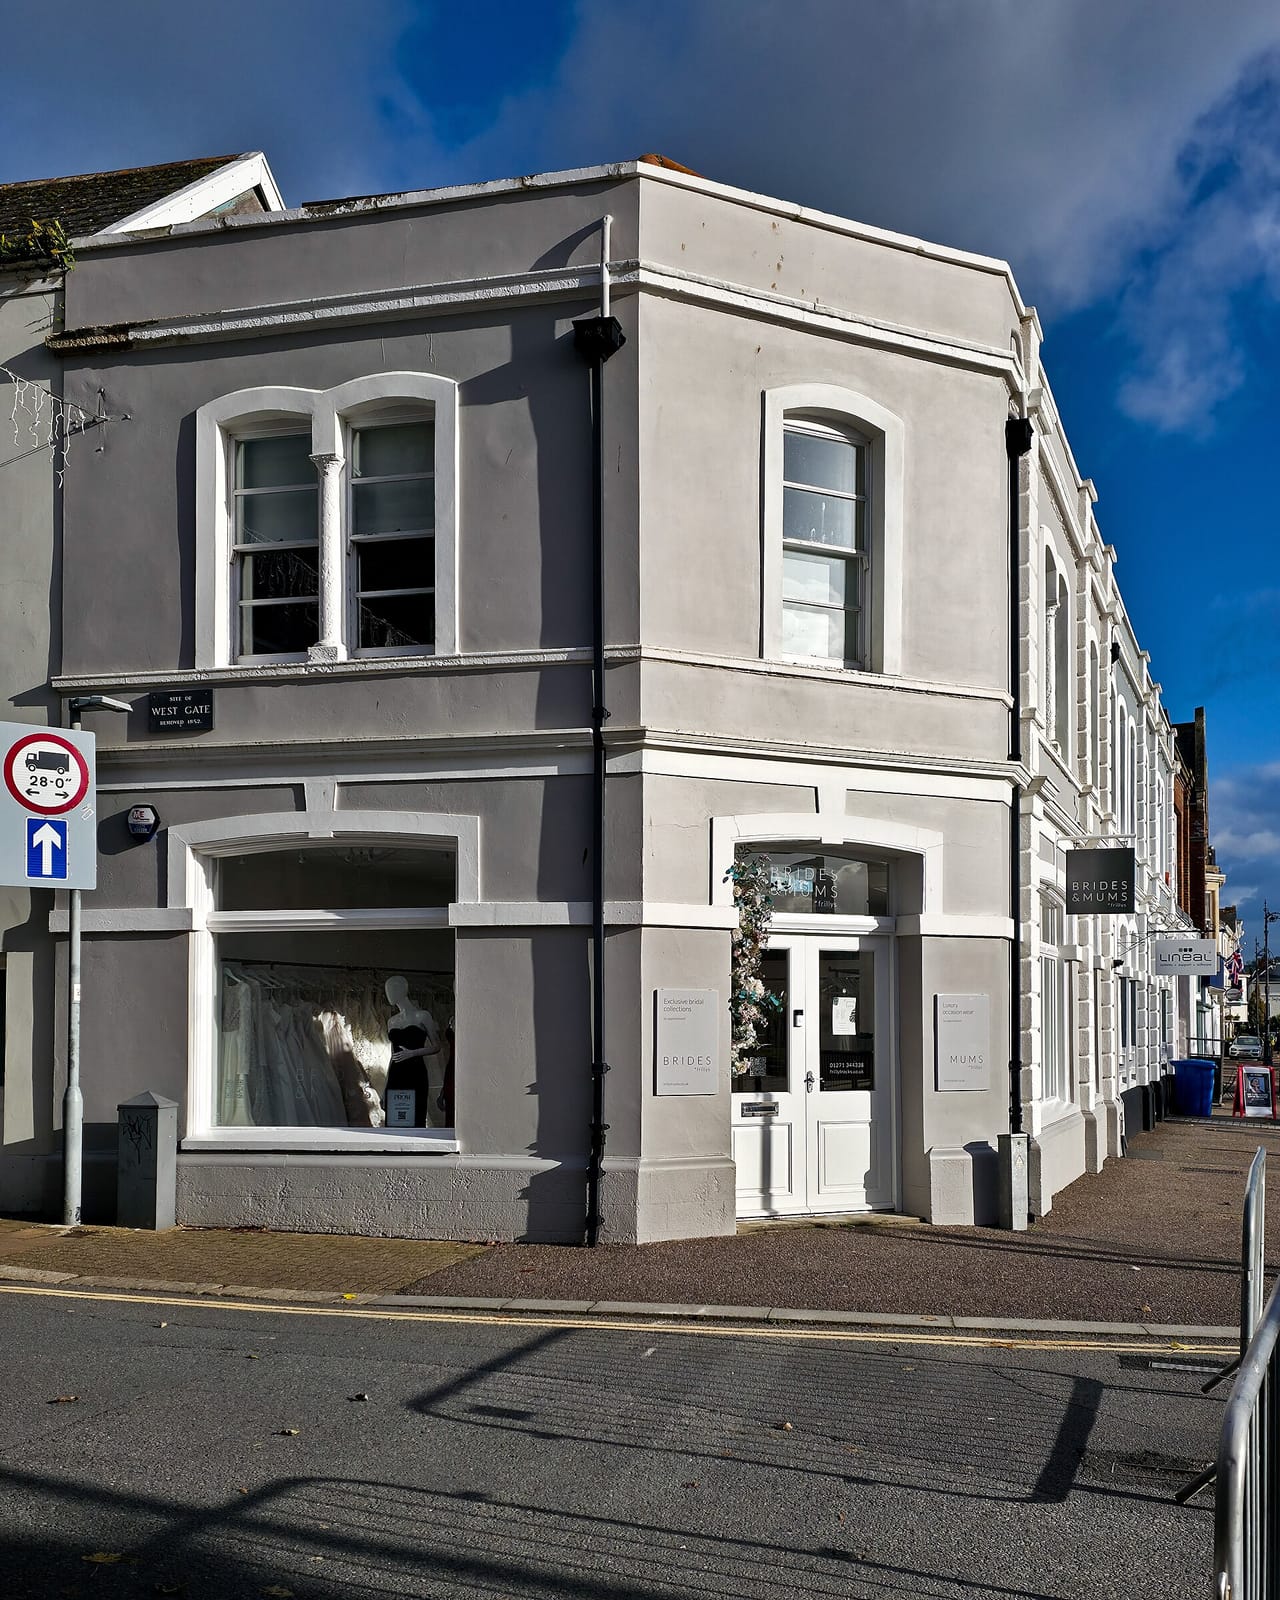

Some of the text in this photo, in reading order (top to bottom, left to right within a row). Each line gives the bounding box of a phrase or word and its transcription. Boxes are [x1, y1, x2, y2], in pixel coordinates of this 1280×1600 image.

[151, 704, 211, 716] WEST GATE
[770, 866, 838, 882] BRIDES
[1072, 880, 1128, 891] BRIDES
[1071, 891, 1128, 902] &MUMS
[663, 997, 705, 1005] Exclusive bridal
[663, 1055, 712, 1066] BRIDES
[950, 1054, 984, 1064] MUMS
